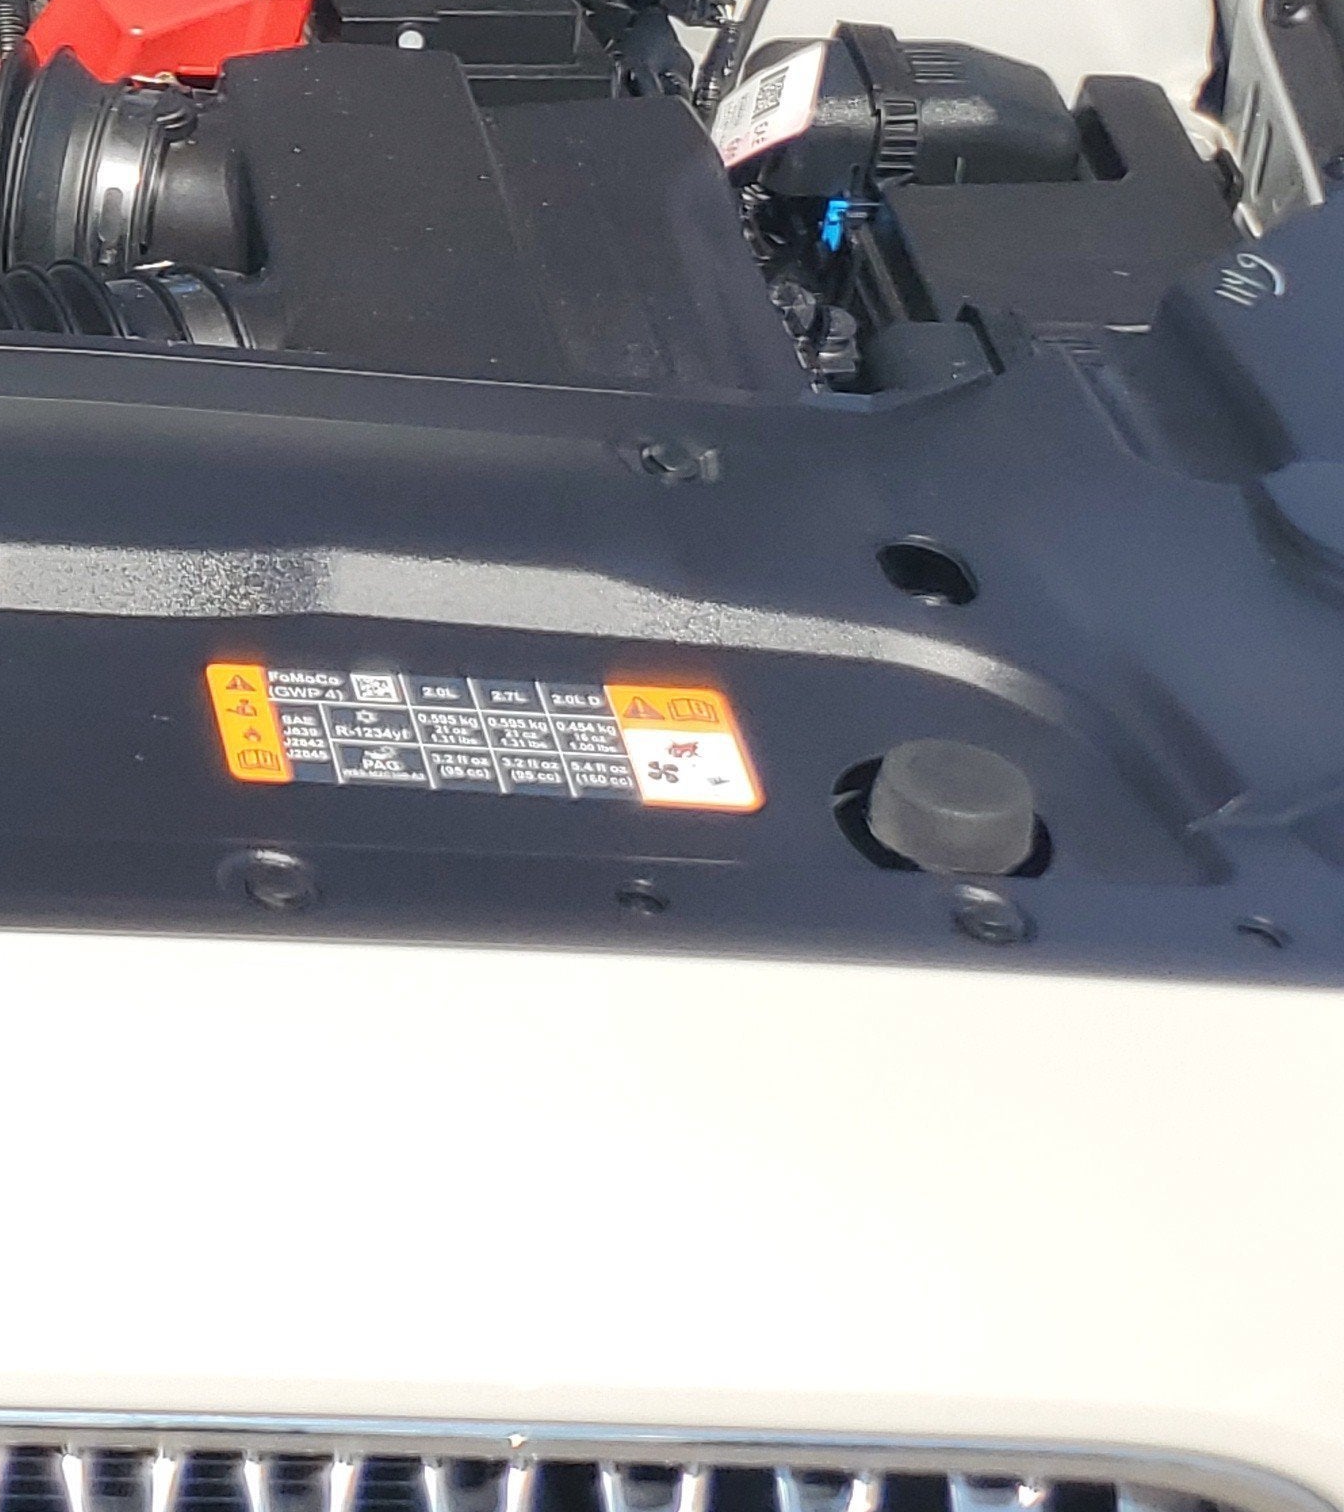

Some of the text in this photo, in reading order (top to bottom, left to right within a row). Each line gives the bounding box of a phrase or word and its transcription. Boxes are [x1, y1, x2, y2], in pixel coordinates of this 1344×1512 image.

[267, 670, 342, 686] FoMoCo
[268, 686, 344, 702] (GWP 4)
[421, 686, 461, 700] 2.0L
[491, 690, 530, 703] 2.7L
[551, 694, 601, 706] 2.0L D
[459, 714, 479, 729] kg
[528, 718, 548, 732] kg
[597, 723, 617, 736] kg
[362, 759, 401, 771] PAG
[431, 753, 454, 764] 3.2
[471, 757, 490, 766] oz
[501, 757, 524, 768] 3.2
[541, 761, 560, 770] oz
[466, 768, 490, 780] cc)
[610, 765, 628, 774] oz
[537, 771, 562, 784] cc)
[610, 775, 633, 787] cc)
